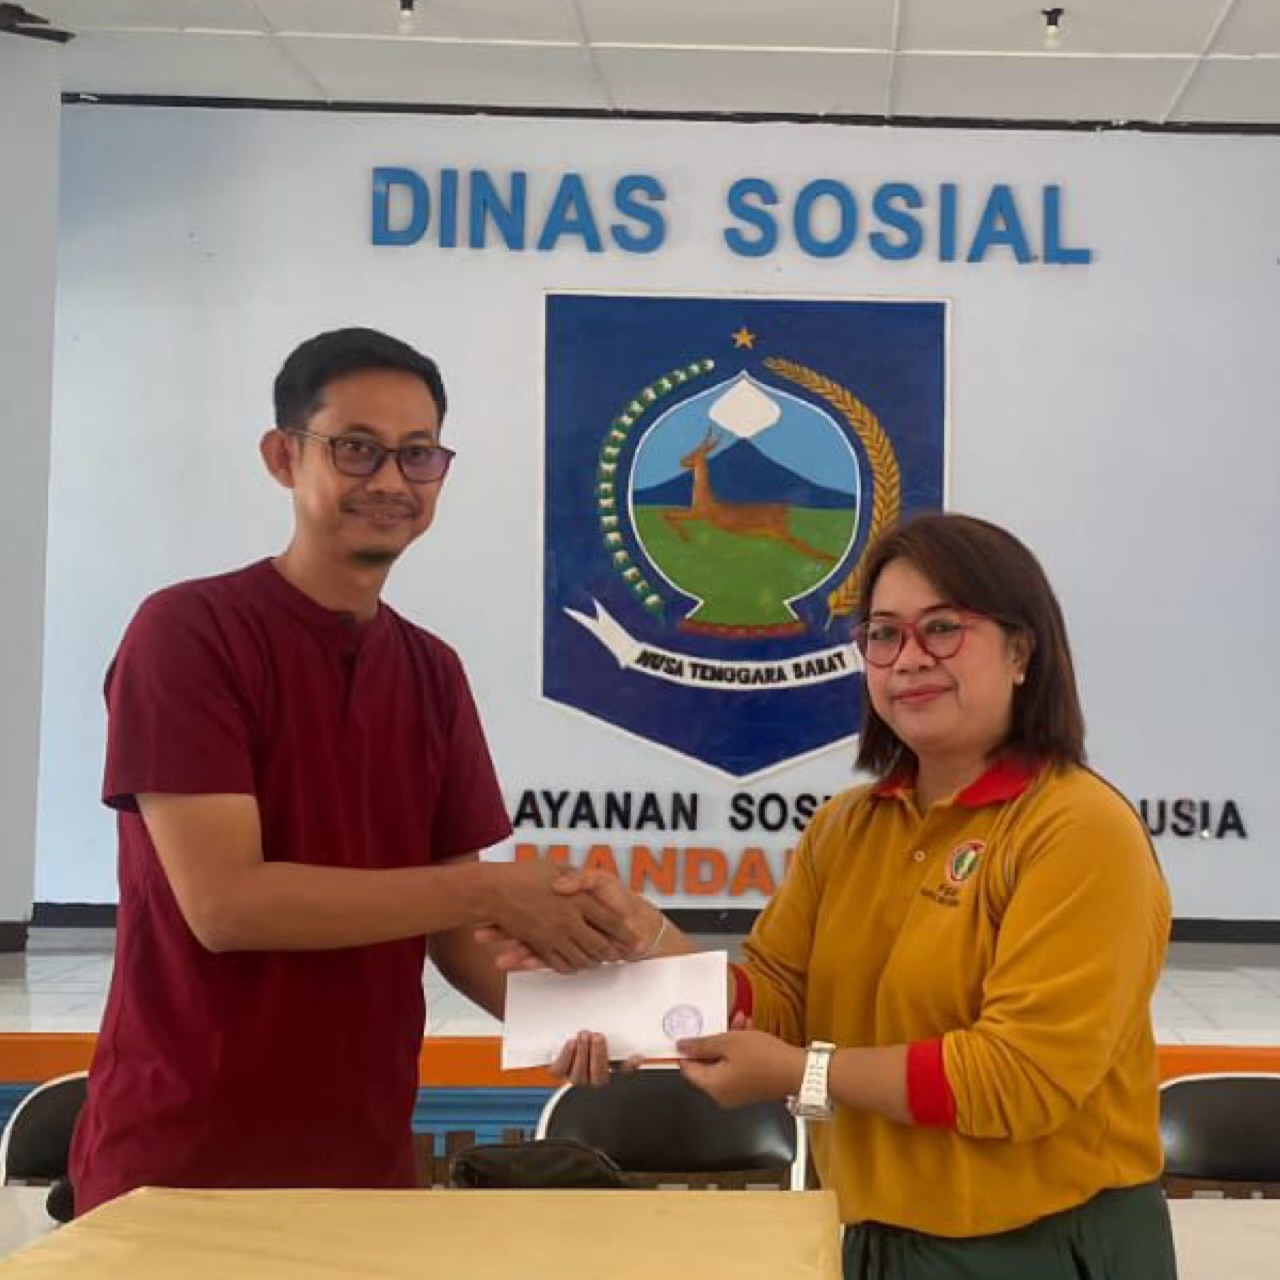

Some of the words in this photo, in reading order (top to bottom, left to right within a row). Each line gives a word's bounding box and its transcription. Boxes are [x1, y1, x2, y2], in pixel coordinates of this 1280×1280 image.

[371, 166, 667, 253] DINAS
[724, 176, 1093, 266] SOSIAL
[636, 649, 684, 677] NUSA
[793, 651, 848, 679] BARAT
